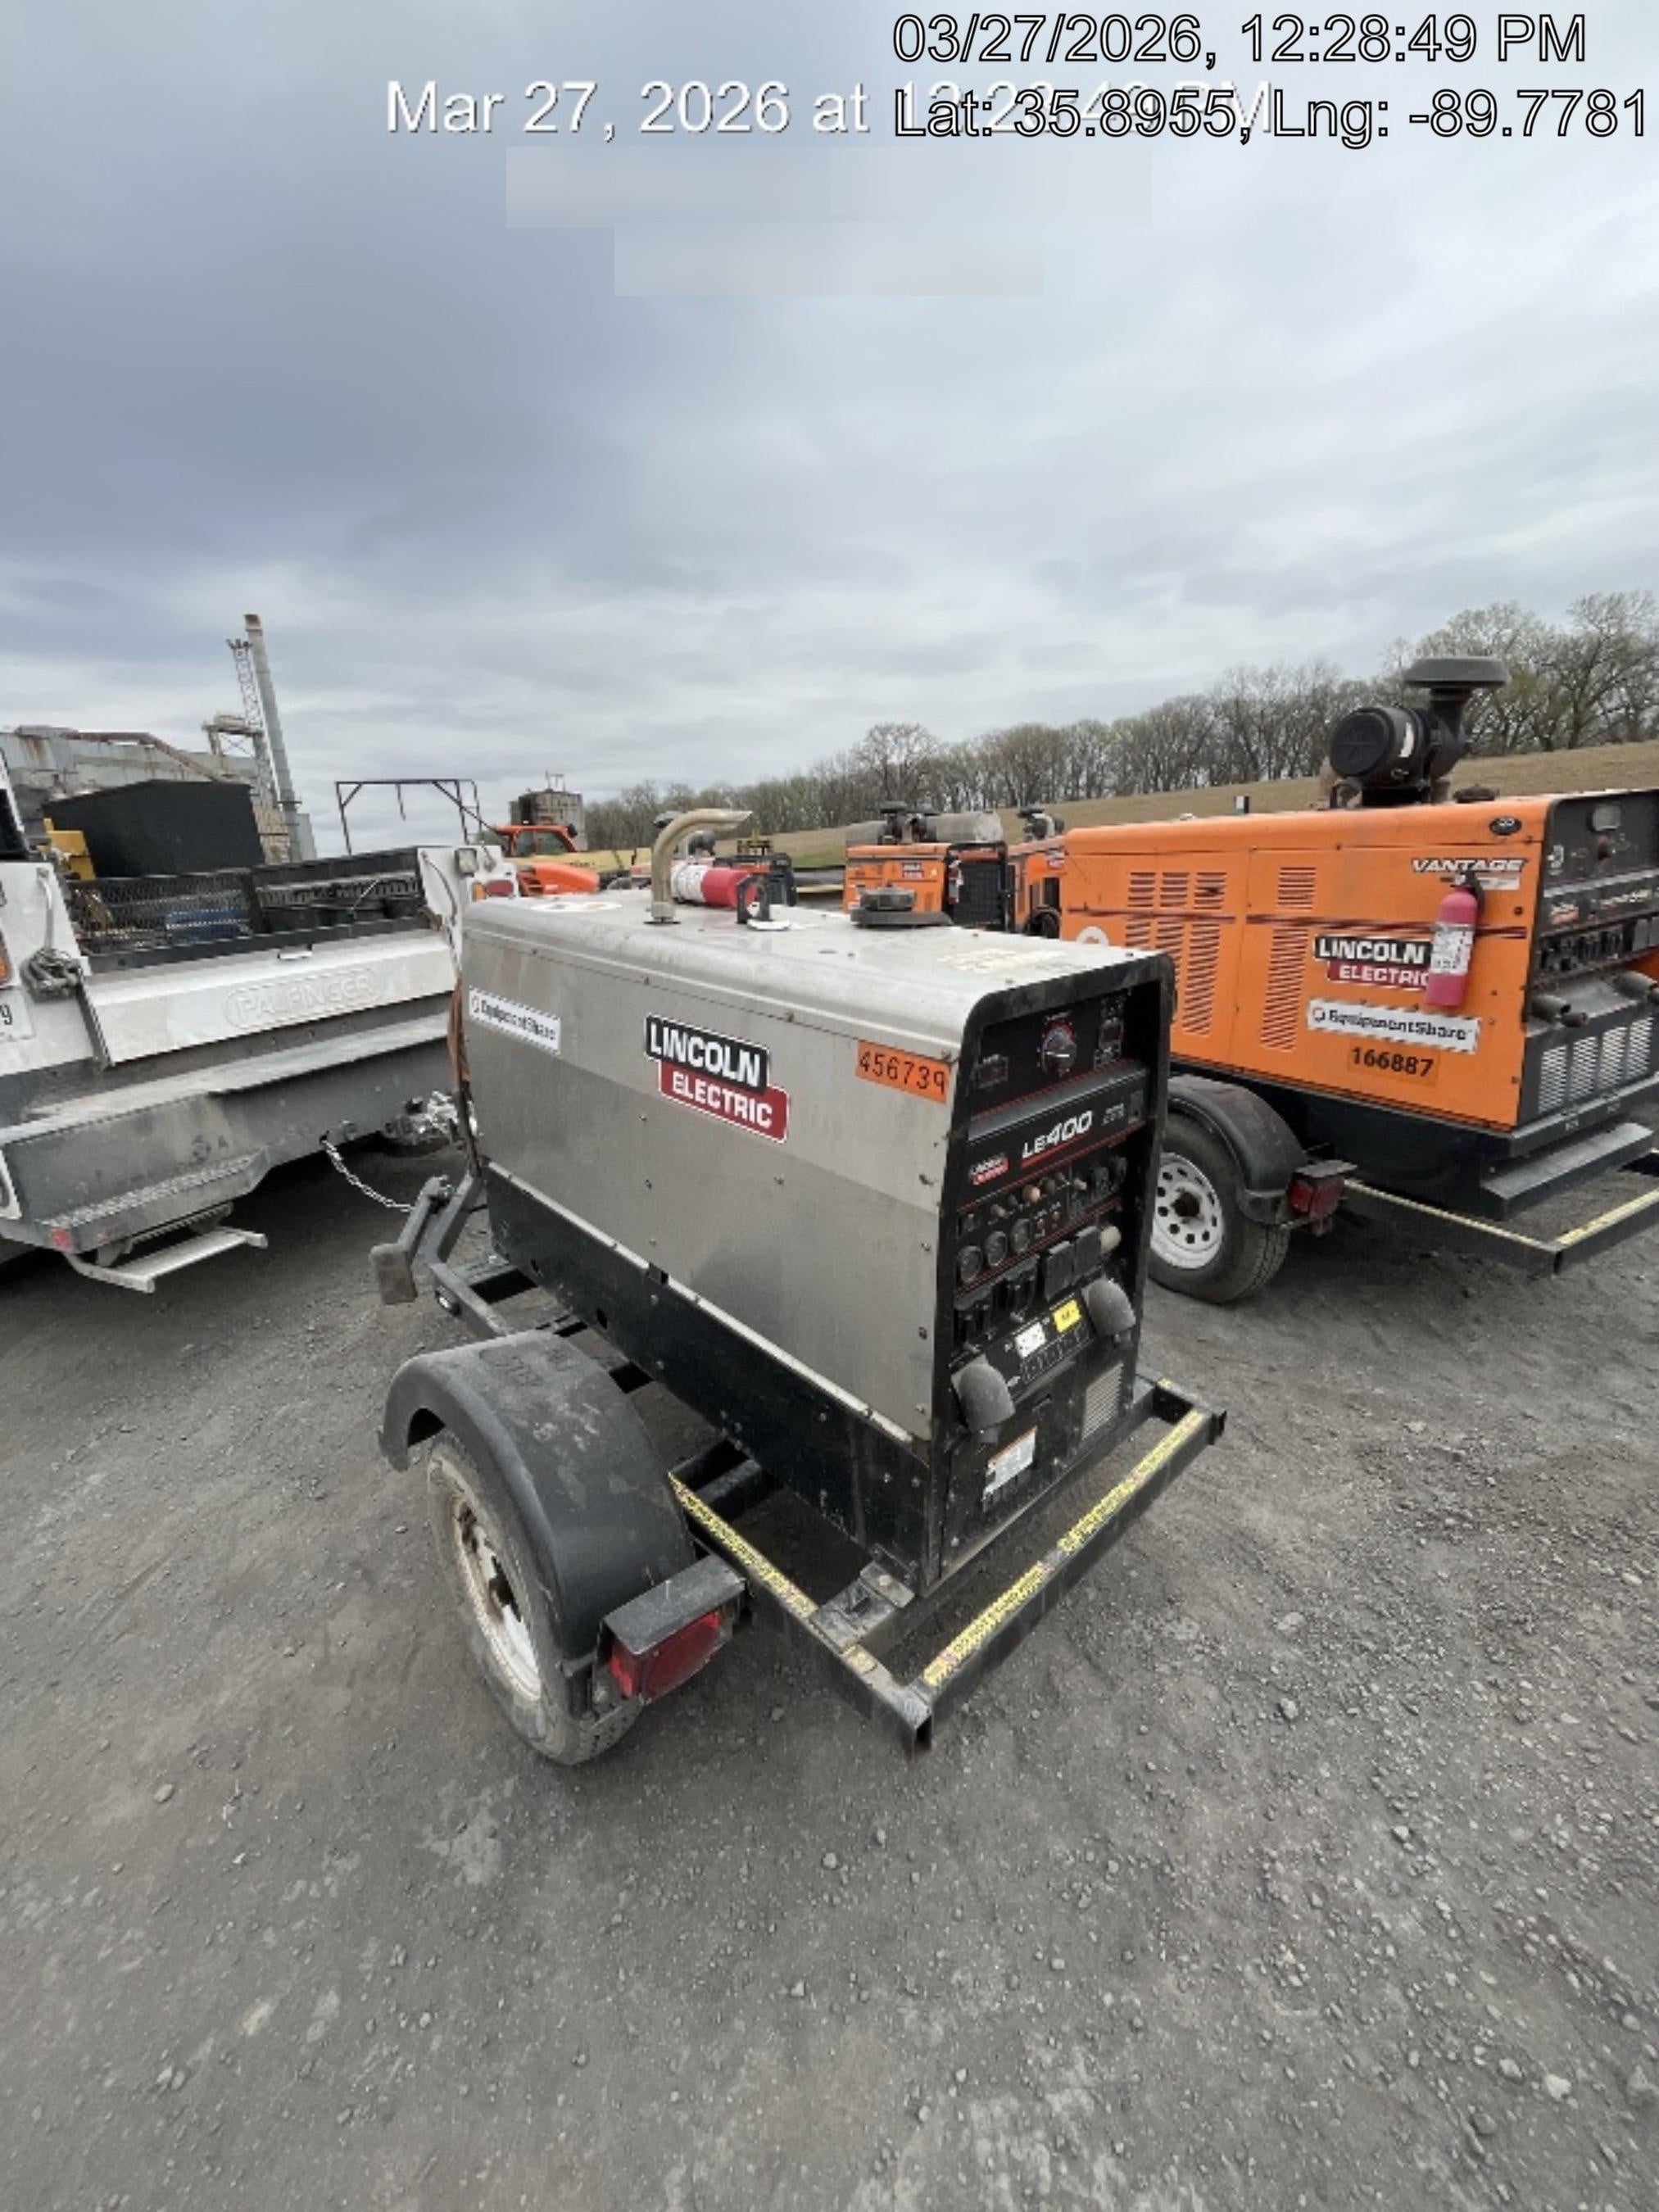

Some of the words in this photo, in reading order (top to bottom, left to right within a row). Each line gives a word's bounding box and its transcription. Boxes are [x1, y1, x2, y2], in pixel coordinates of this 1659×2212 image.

[1412, 859, 1526, 872] VANTAGE
[1319, 938, 1426, 965] LINCOLN
[650, 1022, 760, 1088] LINCOLN
[859, 1051, 945, 1095] 456739
[1352, 1046, 1434, 1077] 166887
[672, 1070, 773, 1129] ELECTRIC
